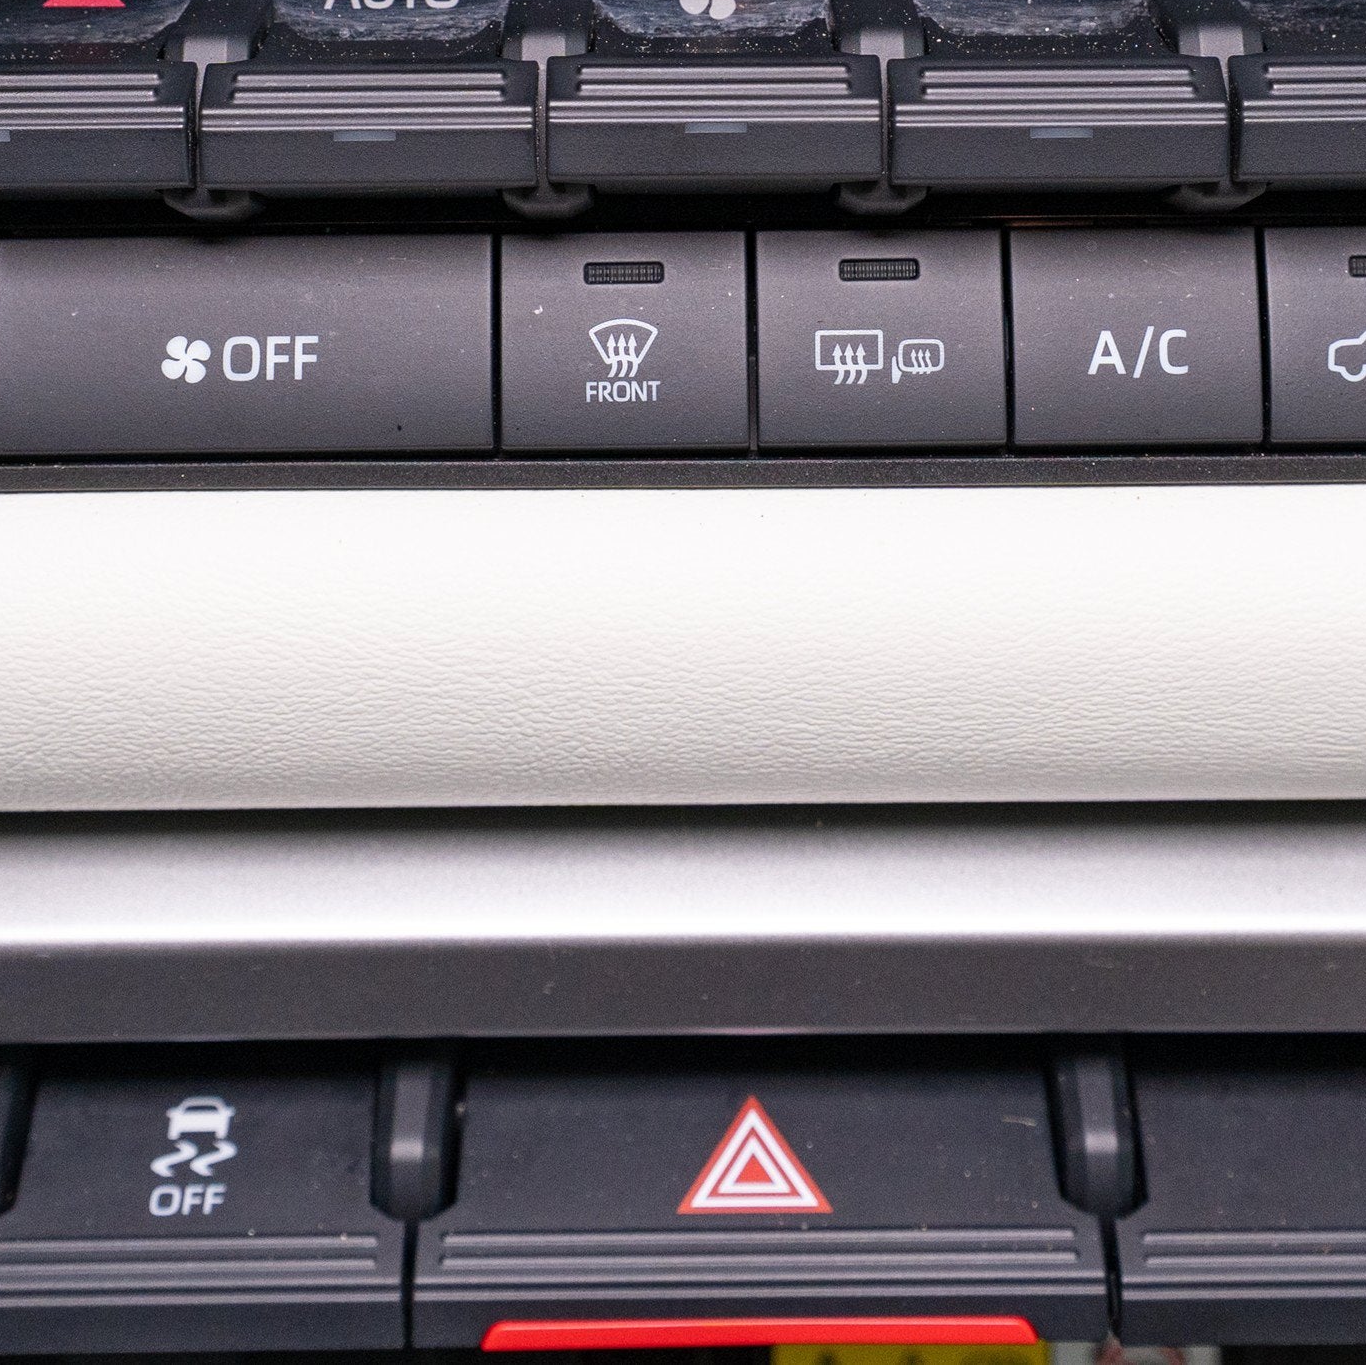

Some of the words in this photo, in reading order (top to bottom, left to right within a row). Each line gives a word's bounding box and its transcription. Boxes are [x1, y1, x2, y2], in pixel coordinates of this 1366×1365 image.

[222, 335, 320, 383] OFF
[1088, 325, 1190, 380] A/C
[585, 380, 662, 404] FRONT
[149, 1183, 227, 1218] OFF
